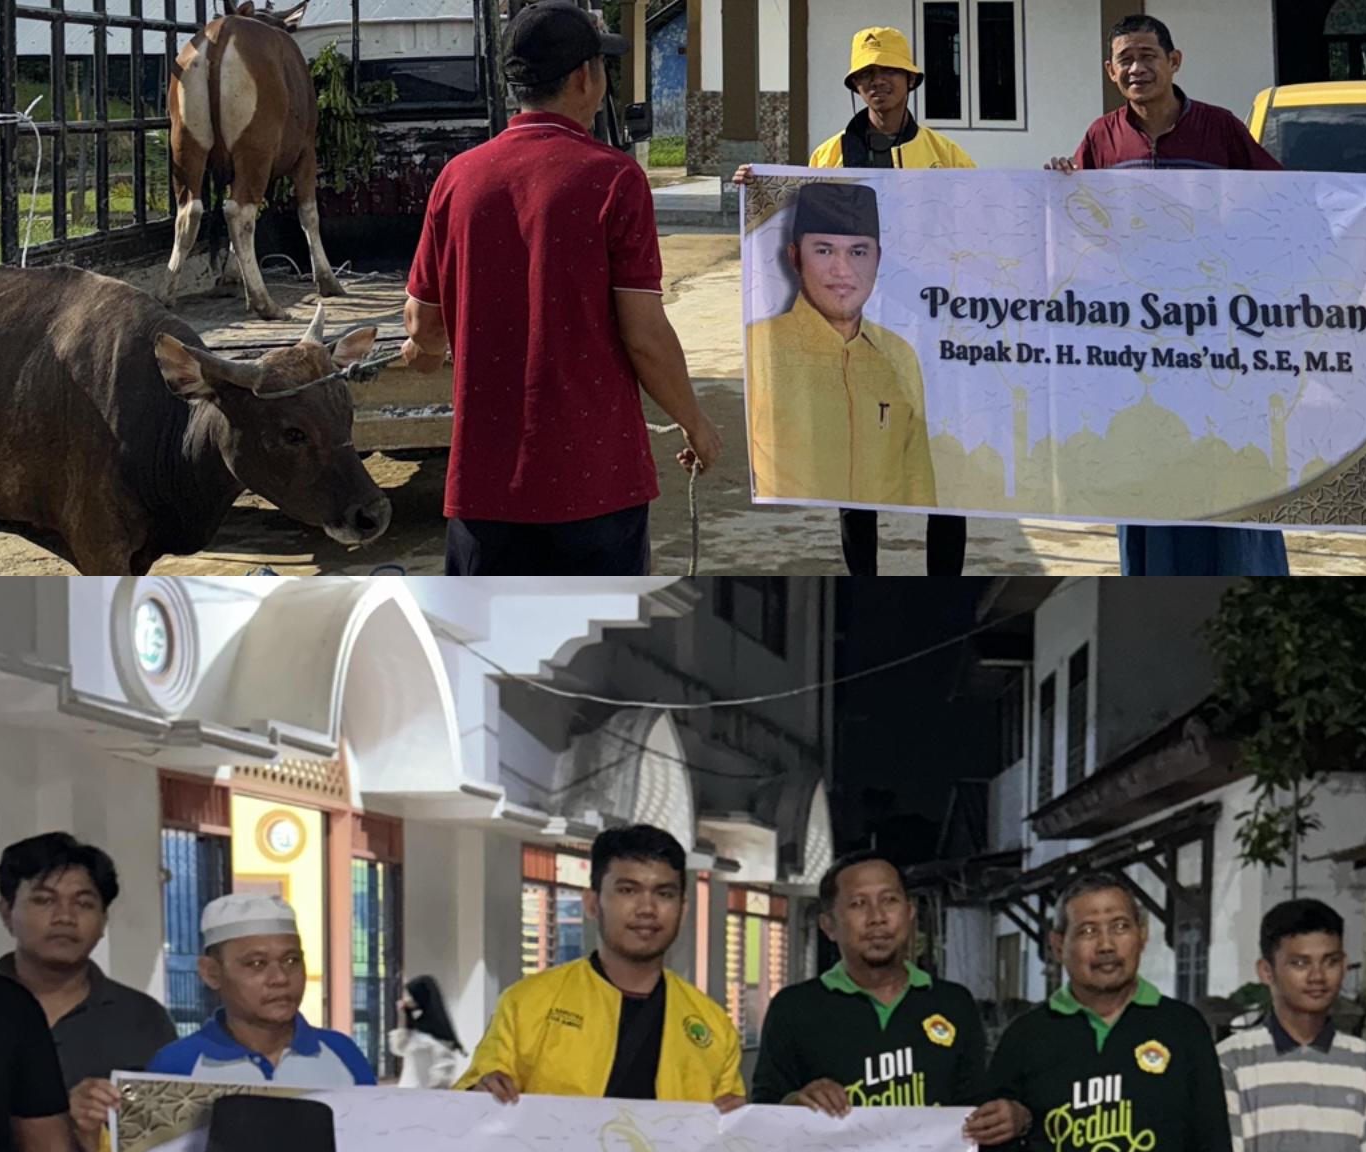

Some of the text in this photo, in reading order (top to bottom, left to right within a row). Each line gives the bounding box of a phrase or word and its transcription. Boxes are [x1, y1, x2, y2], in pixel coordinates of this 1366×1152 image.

[920, 287, 1130, 329] Penyerahan
[1141, 293, 1217, 336] Sapi
[940, 340, 1011, 365] Bapak
[1016, 343, 1050, 363] Dr.
[1056, 345, 1081, 365] H.
[1087, 345, 1147, 373] Rudy
[1253, 350, 1300, 376] S.E,
[1305, 352, 1352, 372] M.E
[865, 1046, 913, 1086] LDII
[1073, 1074, 1122, 1110] LDII
